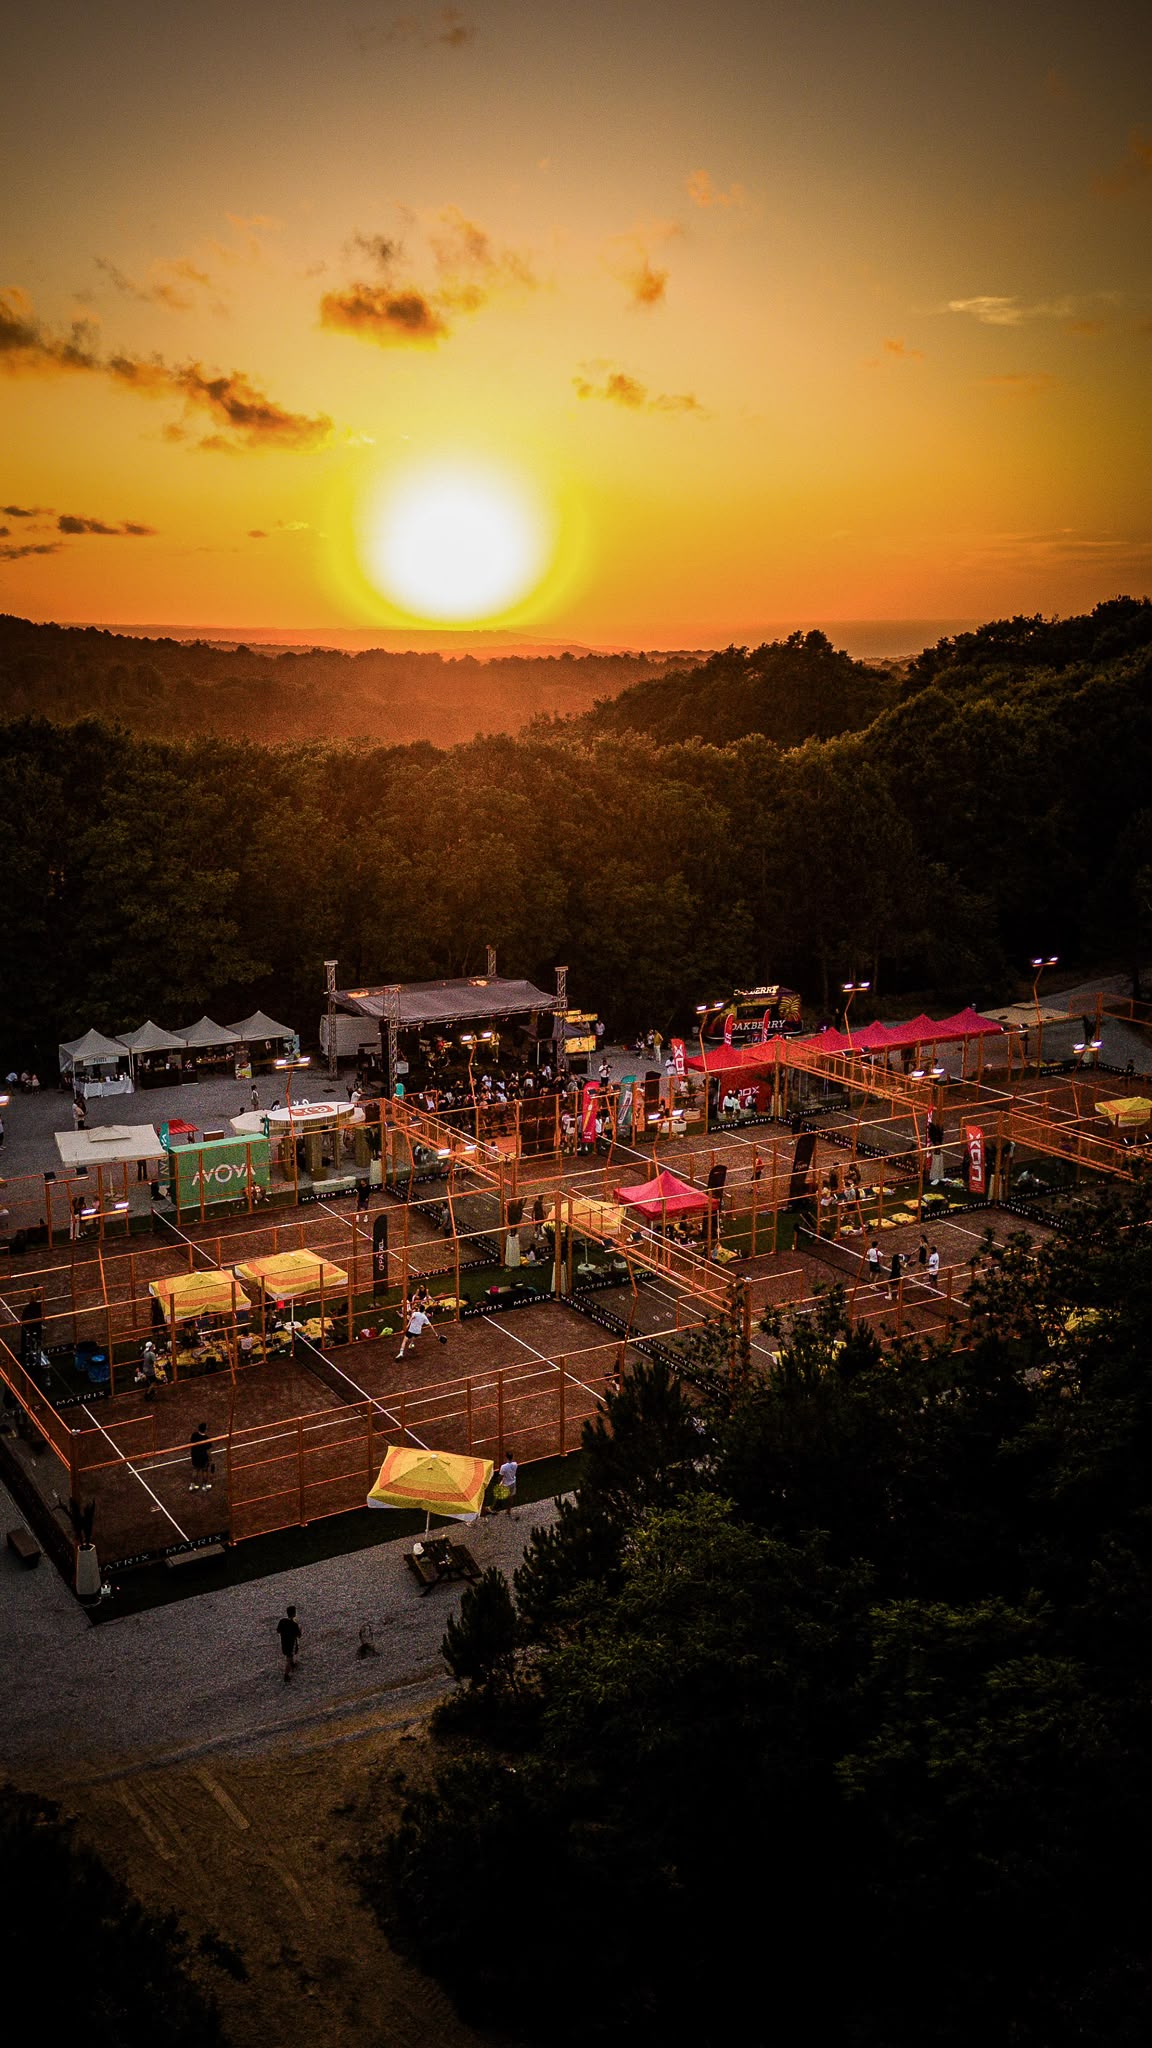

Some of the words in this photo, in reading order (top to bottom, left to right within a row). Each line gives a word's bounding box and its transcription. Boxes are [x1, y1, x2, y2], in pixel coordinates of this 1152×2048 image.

[302, 1192, 336, 1202] MATRIX
[345, 1184, 379, 1195] MAIX
[460, 1258, 497, 1269] MATRIX
[464, 1303, 504, 1316] MATRIX
[513, 1293, 552, 1306] MATRIX
[56, 1390, 105, 1406] MATRIX
[99, 1553, 150, 1571] ATRIX
[166, 1534, 222, 1554] MATRIX
